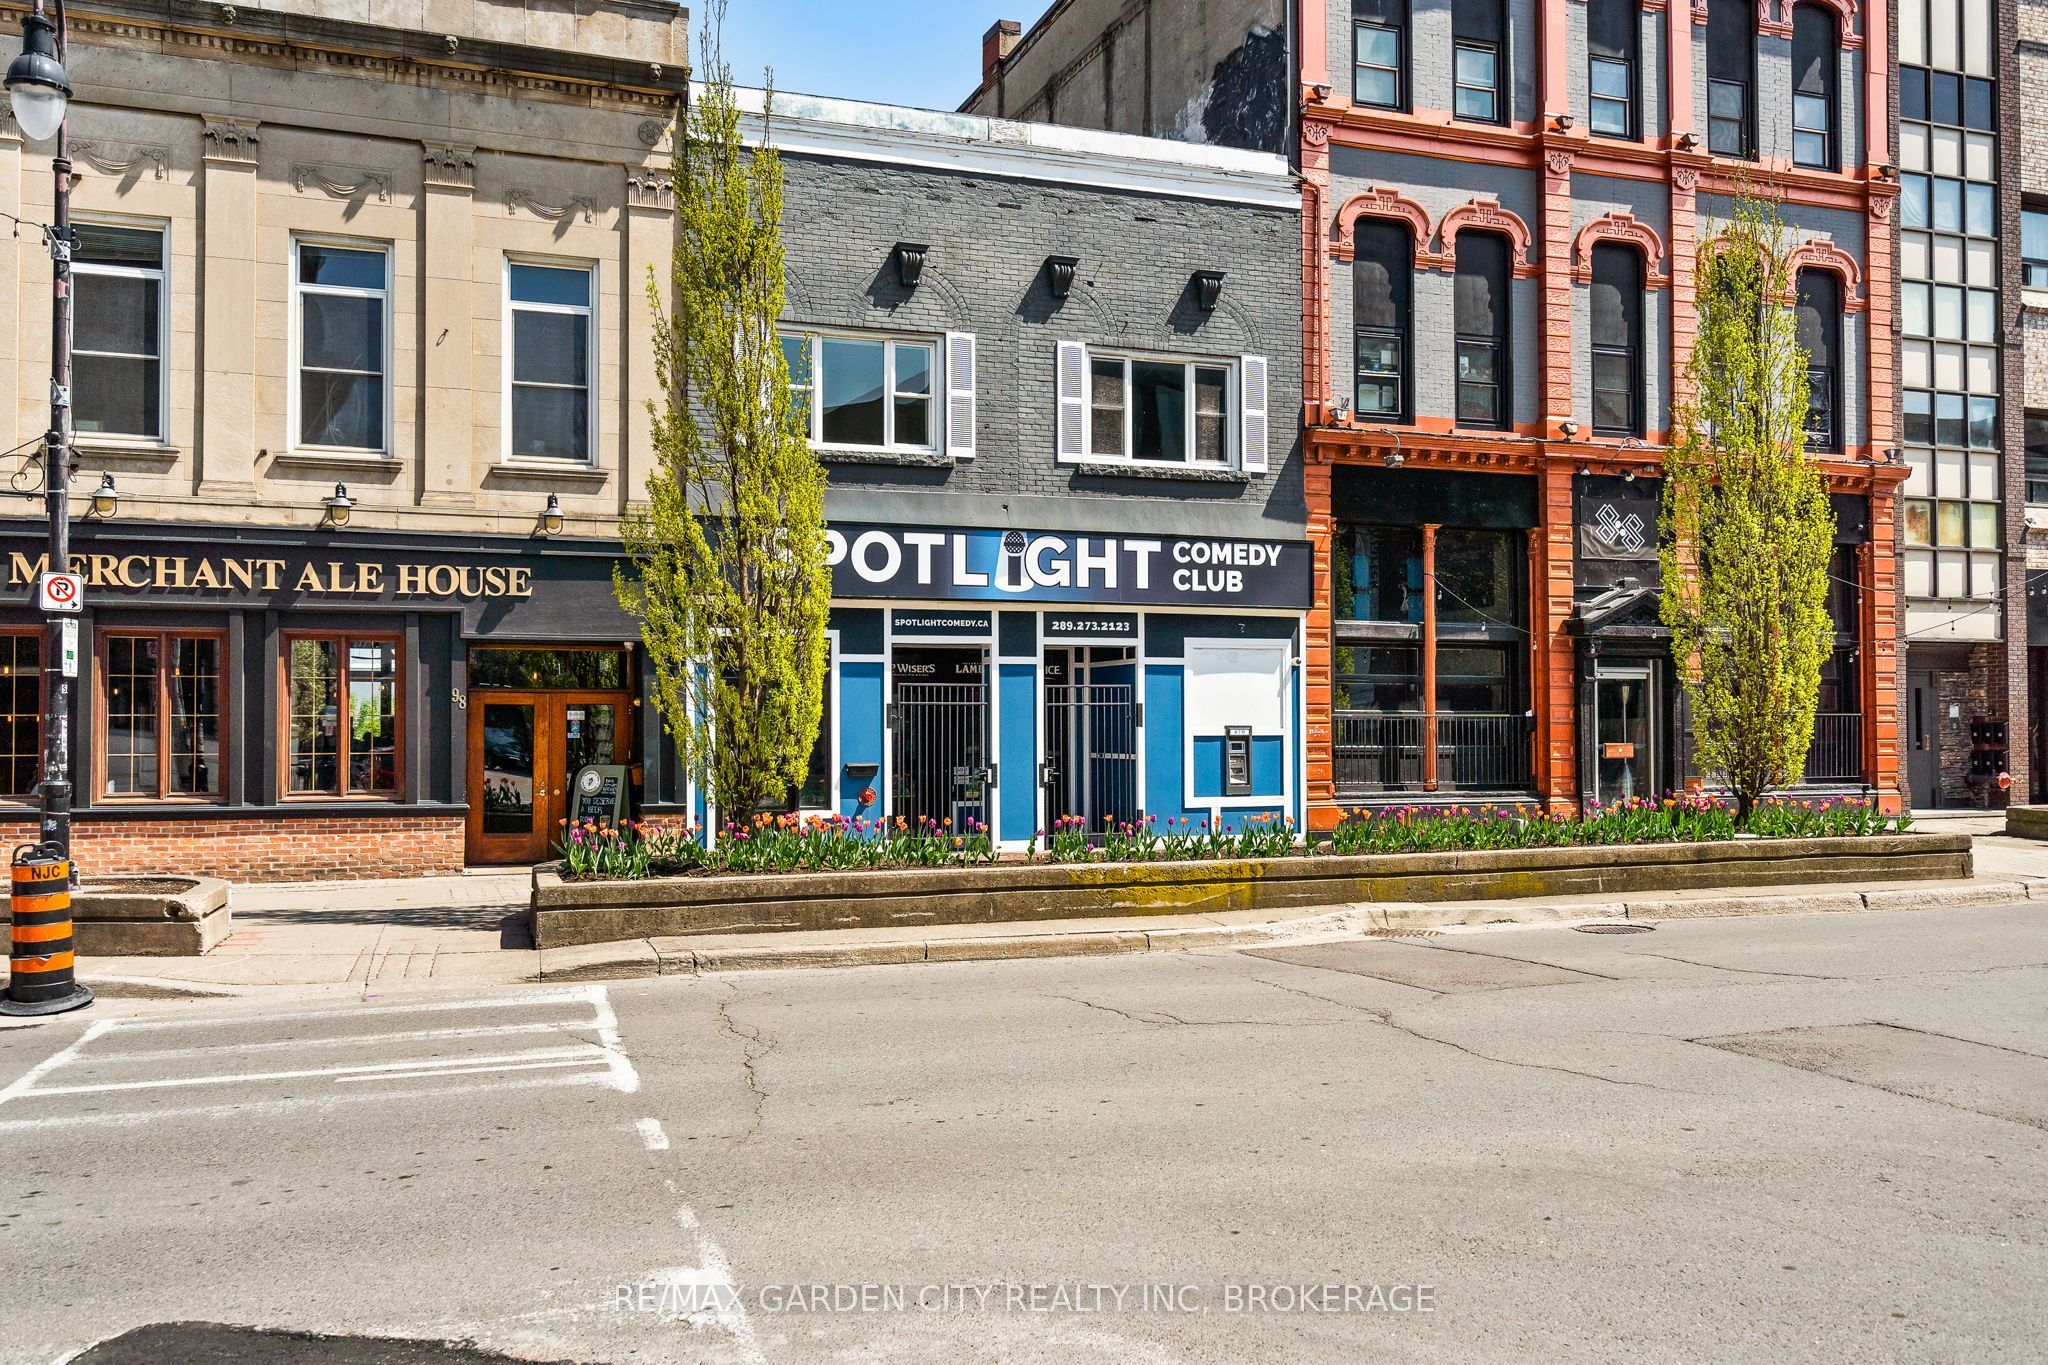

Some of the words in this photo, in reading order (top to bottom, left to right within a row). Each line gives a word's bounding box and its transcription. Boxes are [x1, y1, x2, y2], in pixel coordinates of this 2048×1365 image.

[770, 528, 1162, 591] POTLIGHT
[1172, 541, 1283, 567] COMEDY
[8, 551, 286, 590] MERCHANT
[293, 561, 385, 593] ALE
[395, 563, 534, 597] HOUSE
[1172, 568, 1244, 593] CLUB
[894, 618, 989, 628] SPOTLIGHTCOMEDY.CA
[1051, 621, 1130, 631] 289.273.2123
[451, 688, 467, 710] 98
[32, 866, 60, 880] NJC
